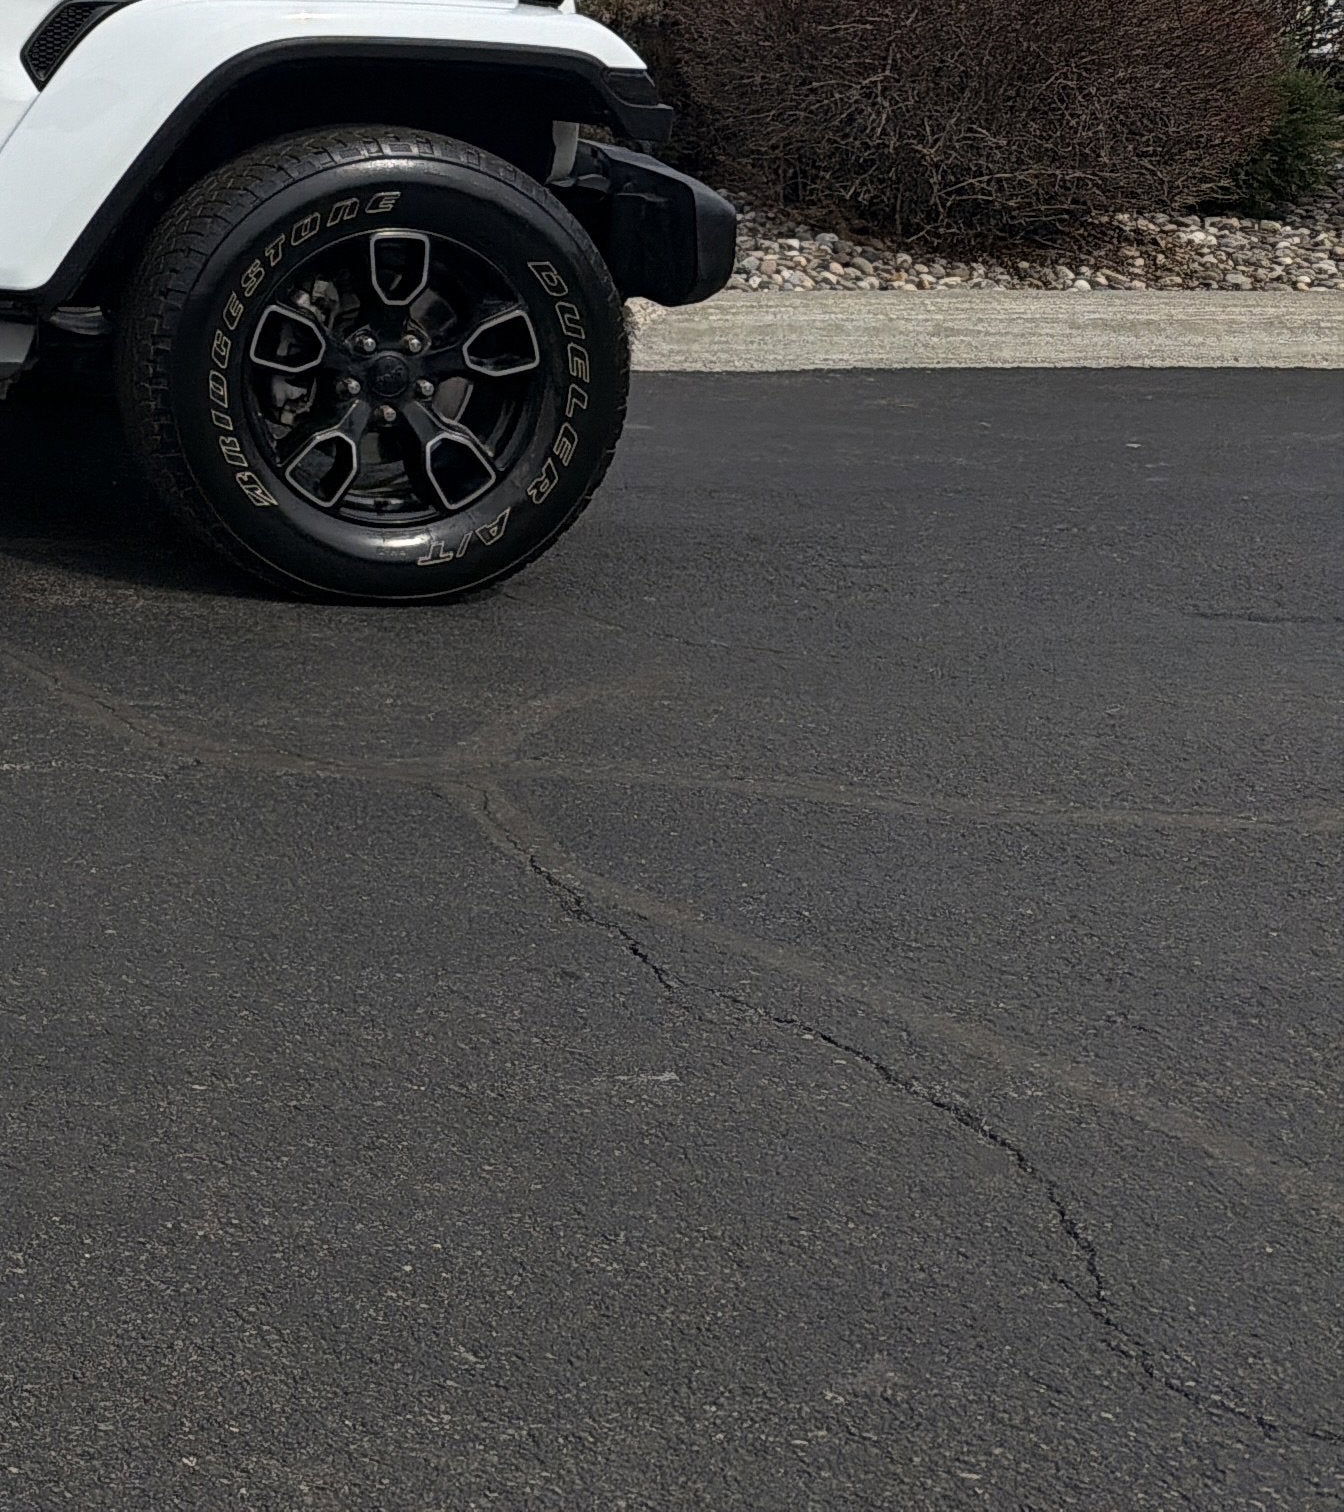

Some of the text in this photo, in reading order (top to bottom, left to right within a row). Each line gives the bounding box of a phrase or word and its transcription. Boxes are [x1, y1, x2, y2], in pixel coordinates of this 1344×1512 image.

[206, 191, 401, 508] BRIDGESTONE
[417, 259, 591, 566] DUELER A/T
